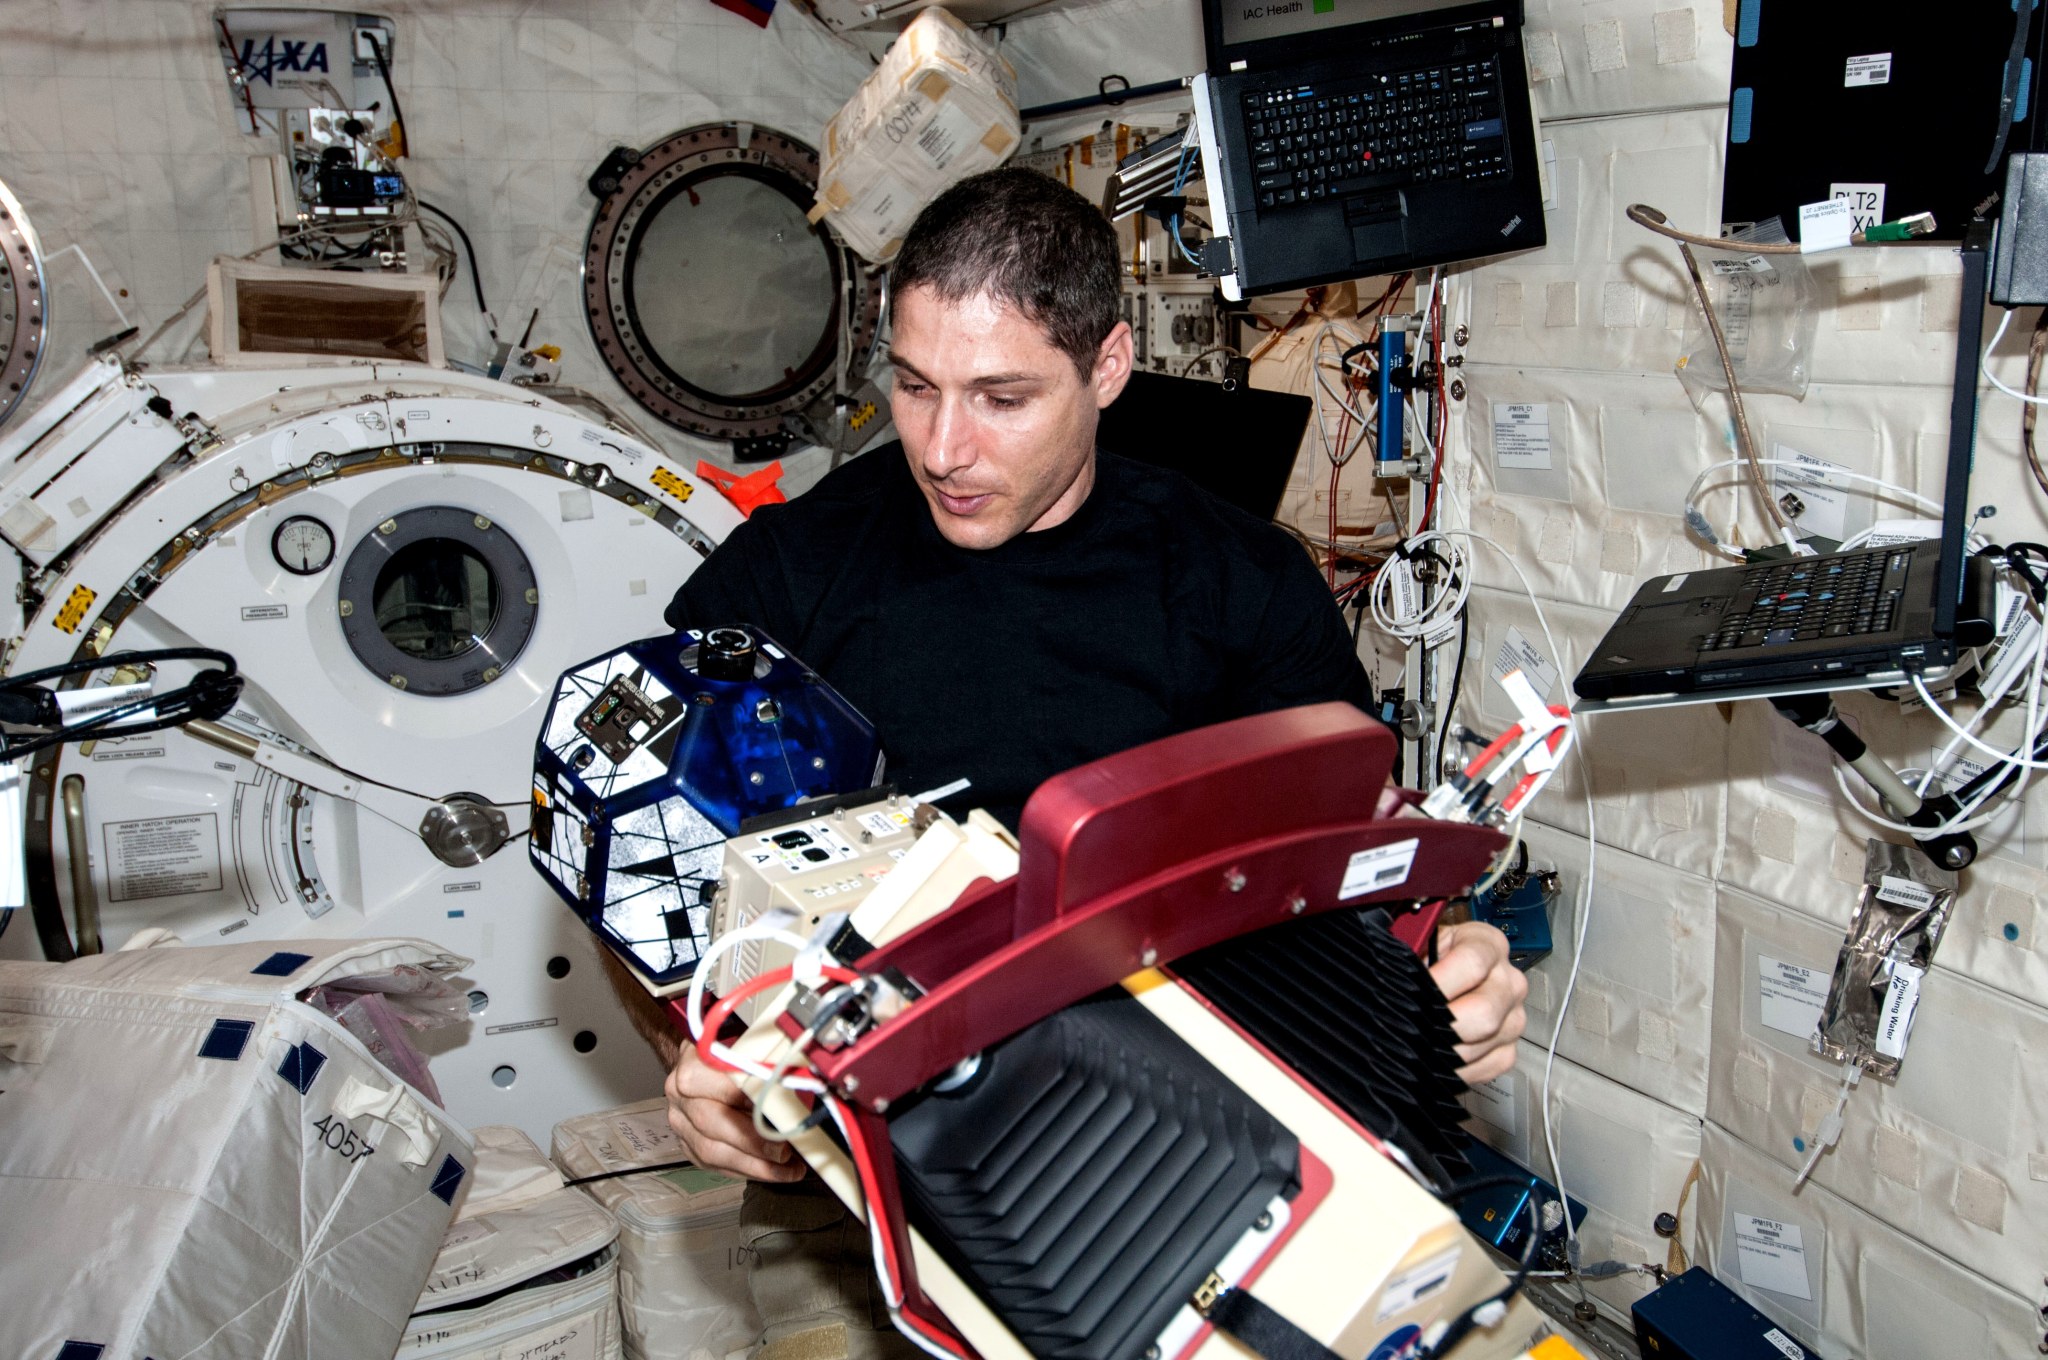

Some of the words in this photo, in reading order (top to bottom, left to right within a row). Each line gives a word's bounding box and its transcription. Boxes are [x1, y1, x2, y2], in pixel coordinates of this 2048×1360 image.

[1243, 7, 1263, 21] IAC
[1266, 1, 1303, 18] Health
[239, 35, 329, 87] JAXA
[1973, 190, 2000, 217] ThinkPad
[1500, 214, 1522, 237] ThinkPad
[619, 675, 638, 695] SPHERES
[634, 689, 654, 709] CONTROL
[651, 703, 665, 719] PANEL
[165, 817, 201, 825] OPERATION
[751, 854, 770, 864] A
[1890, 979, 1910, 1015] Drinking
[1885, 1015, 1899, 1041] Water
[313, 1114, 375, 1163] 4057
